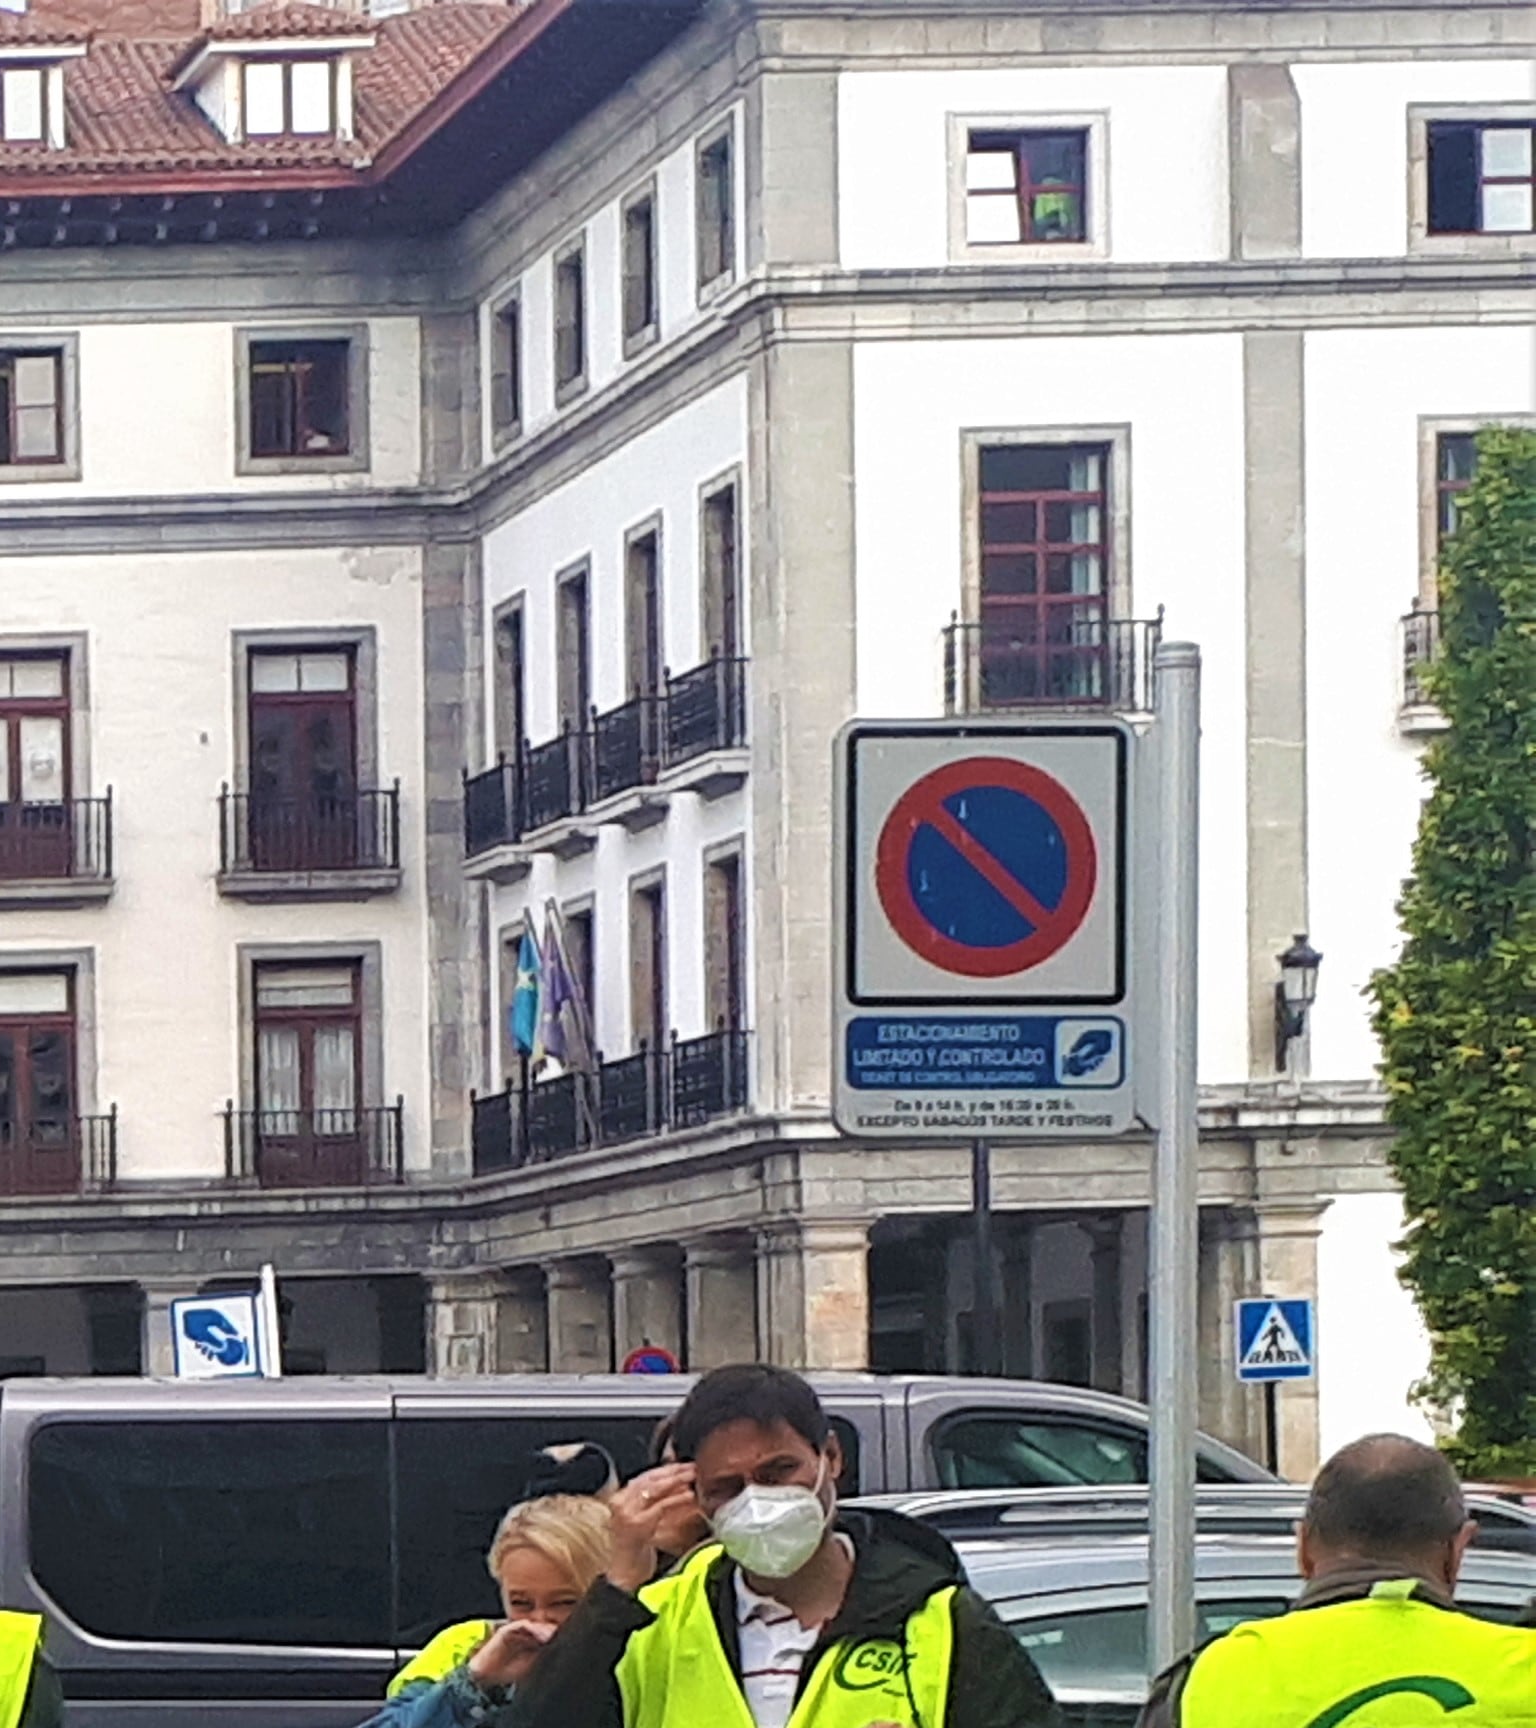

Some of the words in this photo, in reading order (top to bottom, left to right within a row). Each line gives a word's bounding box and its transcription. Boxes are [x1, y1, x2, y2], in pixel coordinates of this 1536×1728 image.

[877, 1023, 1020, 1043] ESTACIONAMIENTO
[853, 1047, 923, 1067] LIMITADO
[938, 1047, 1045, 1066] CONTROLADO
